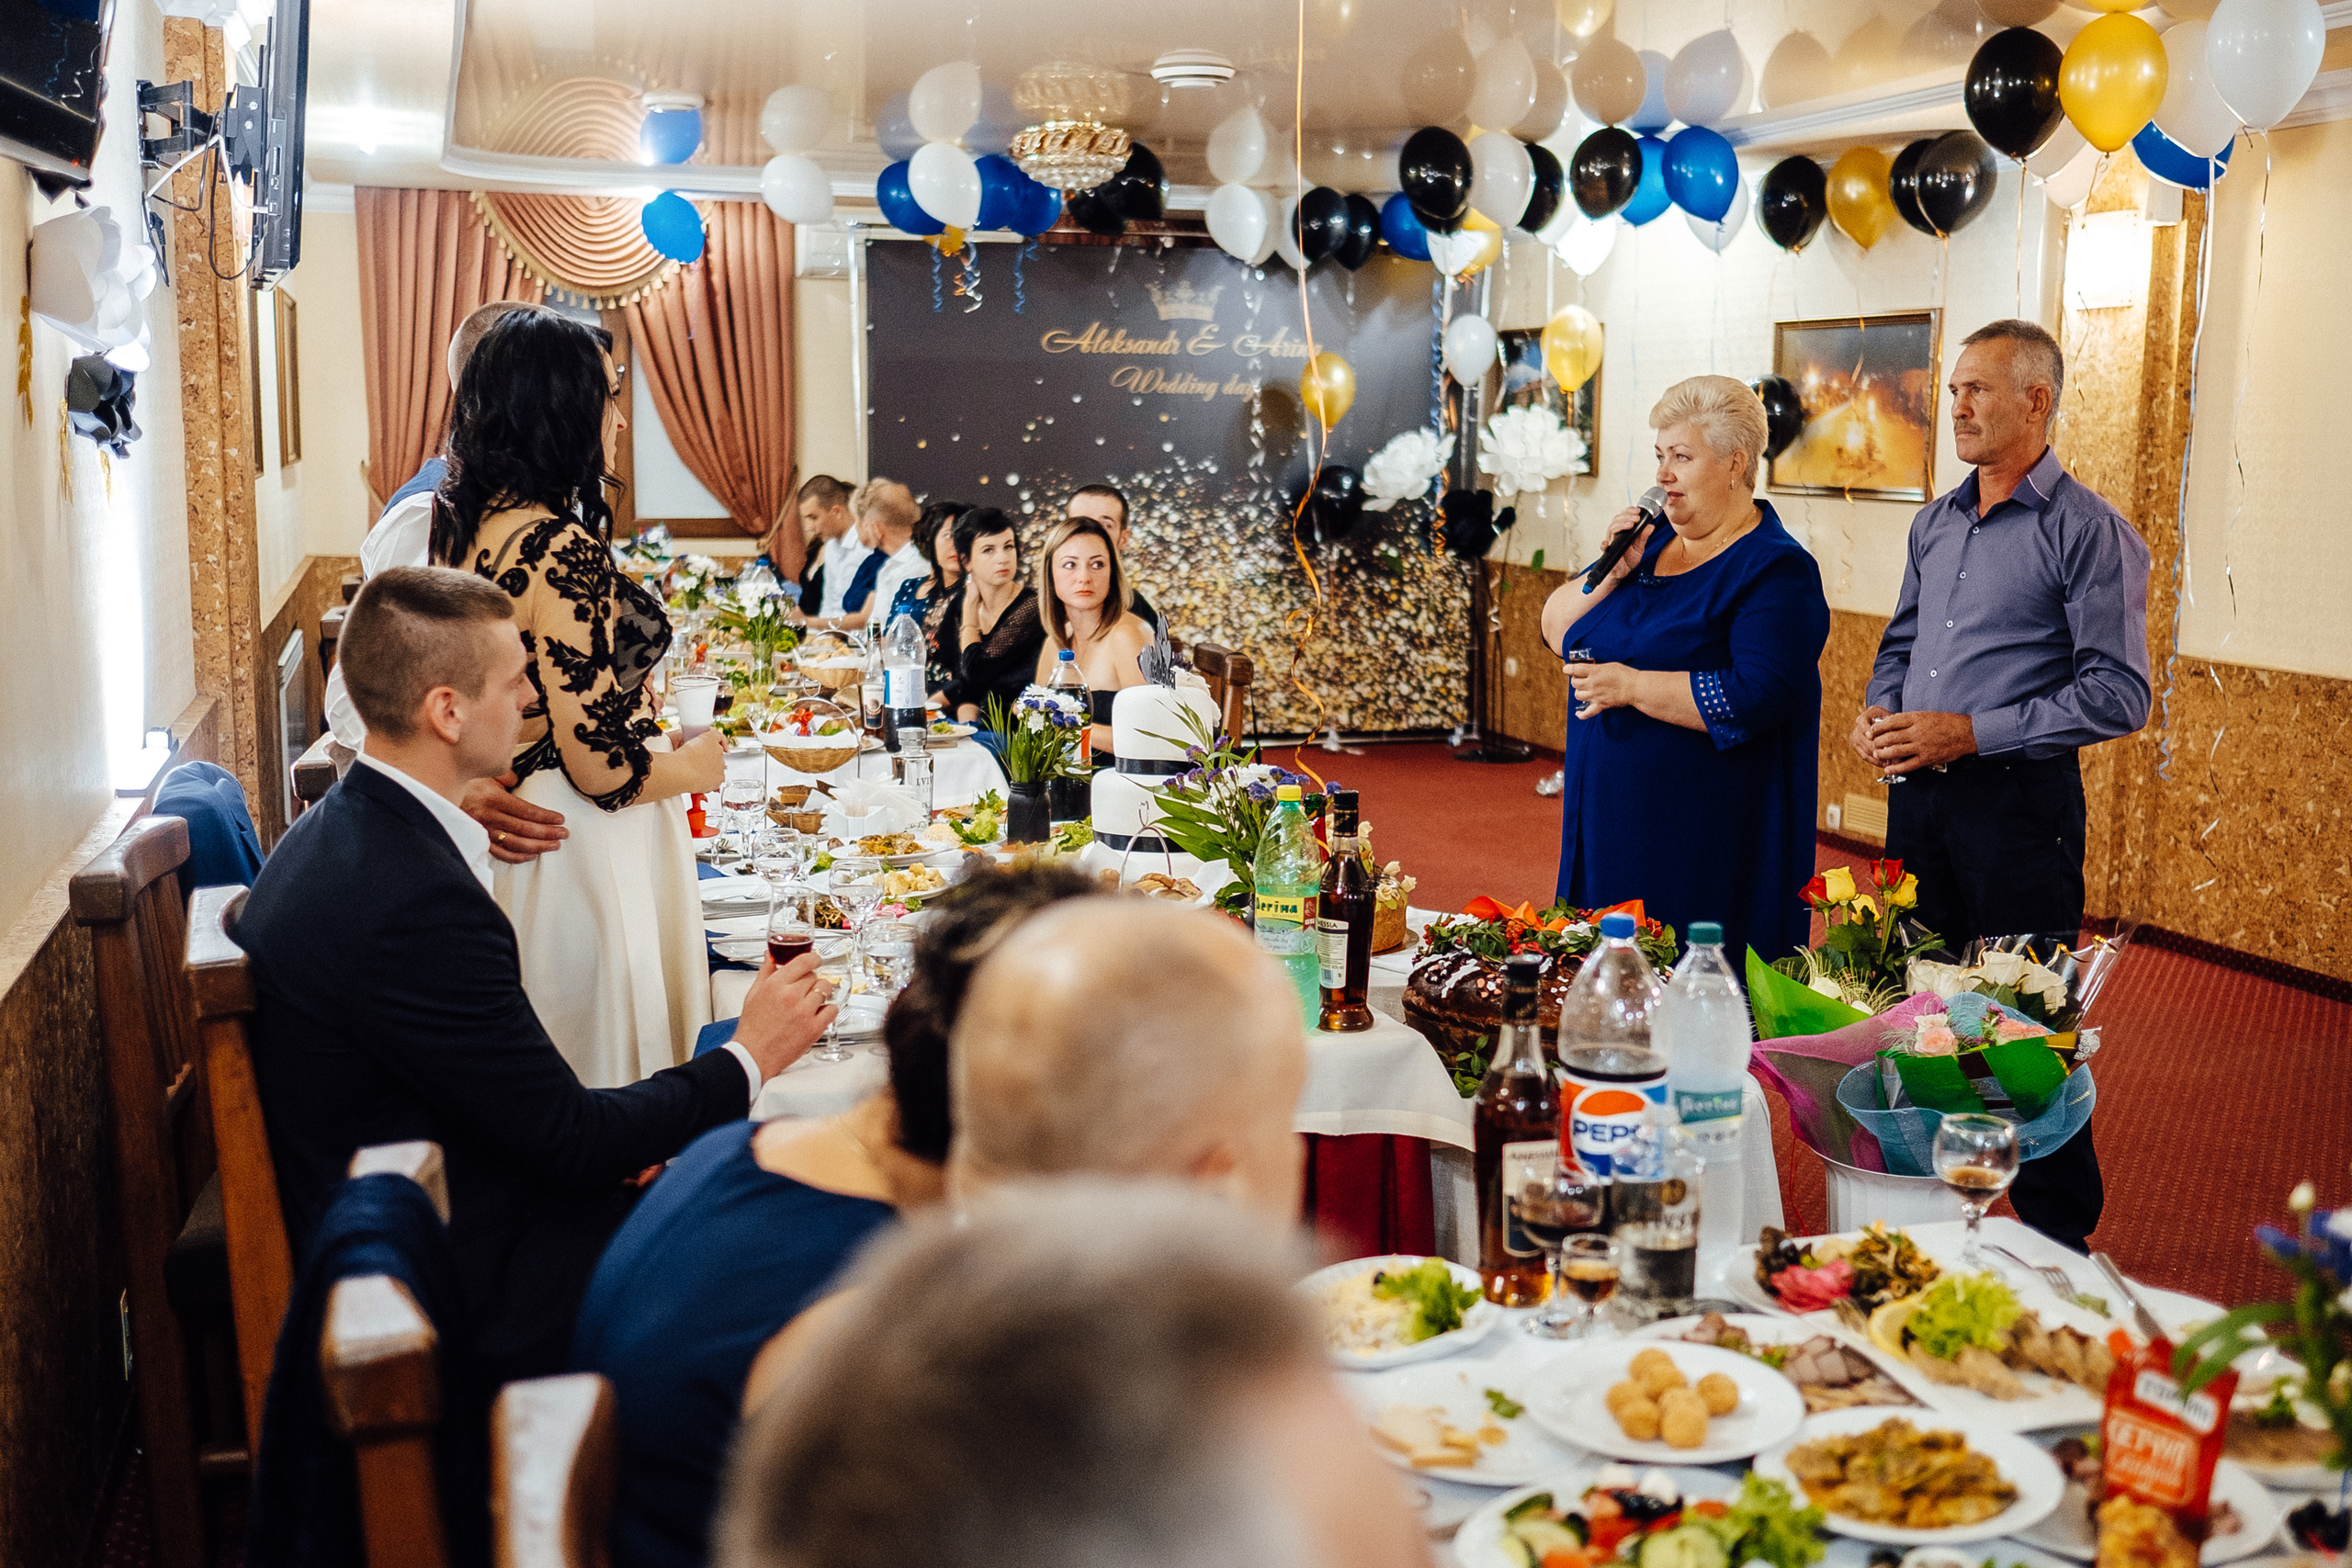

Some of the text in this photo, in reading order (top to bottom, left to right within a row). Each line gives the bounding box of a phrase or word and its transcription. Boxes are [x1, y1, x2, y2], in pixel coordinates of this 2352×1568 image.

[1041, 321, 1181, 355] Aleksandr
[1111, 366, 1254, 402] Wedding day
[1572, 1119, 1640, 1143] PEP
